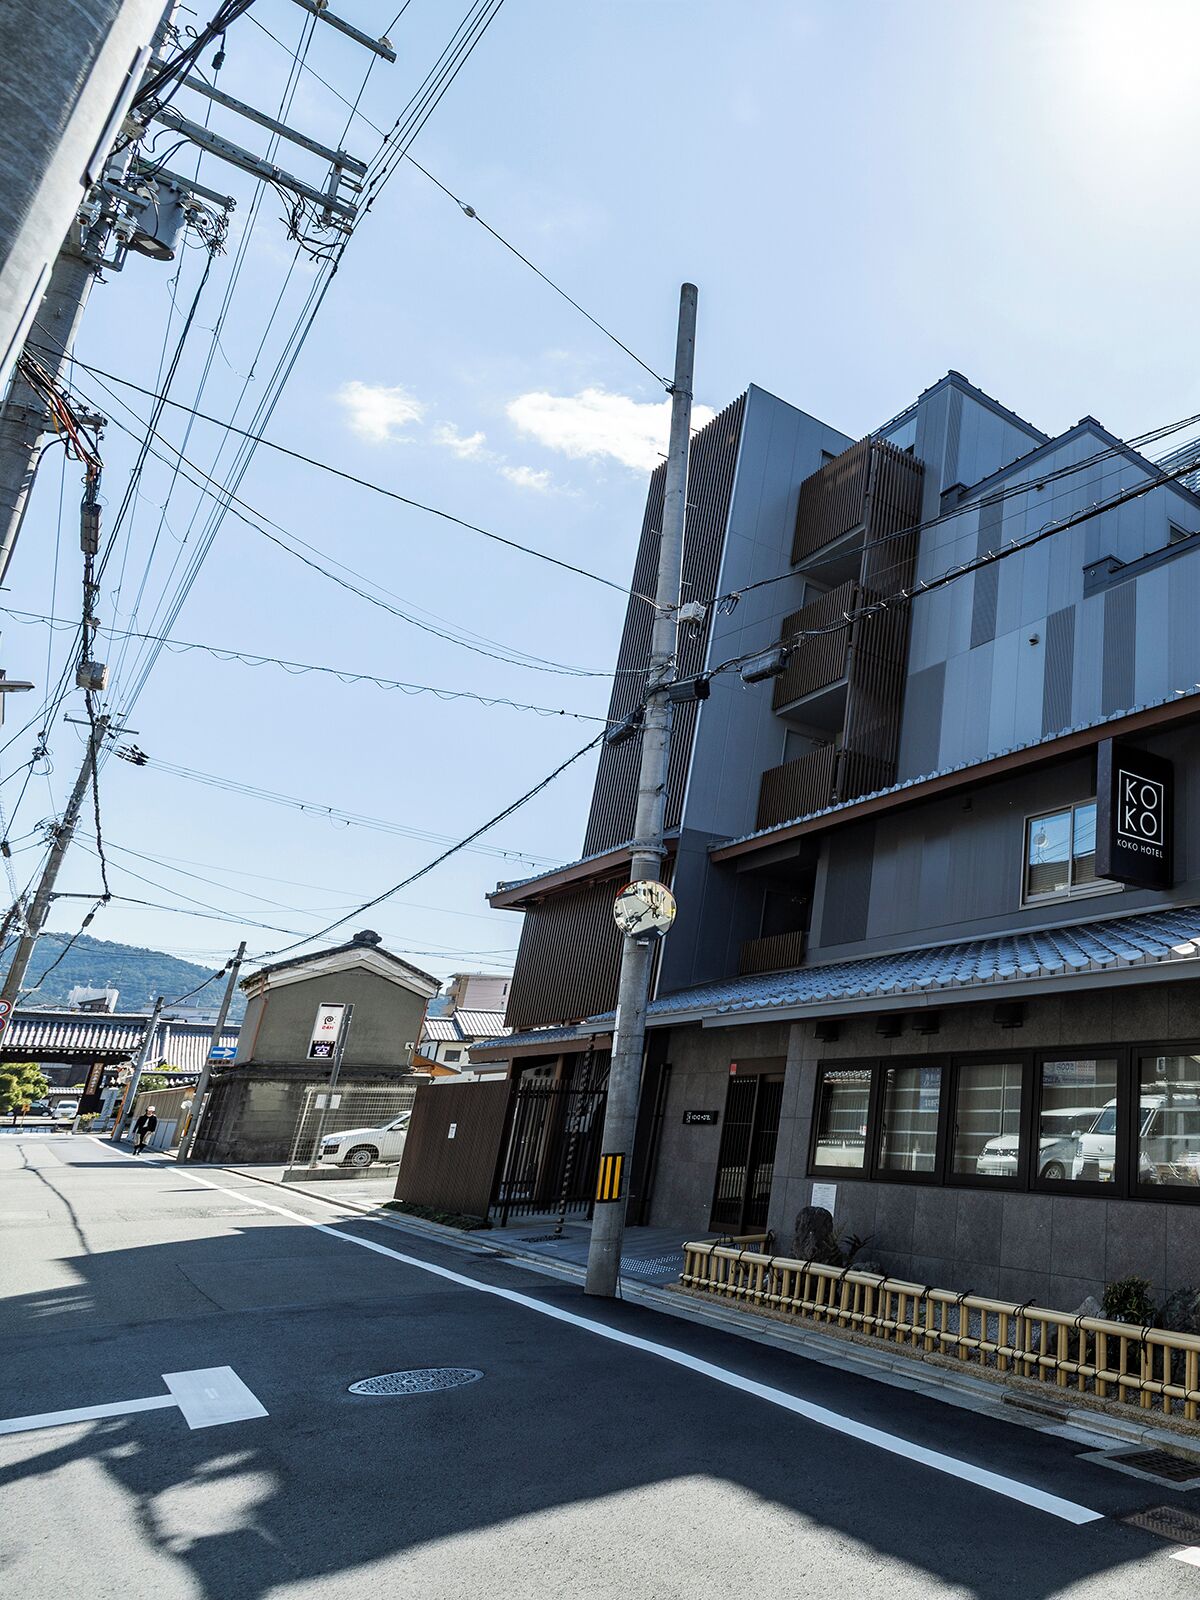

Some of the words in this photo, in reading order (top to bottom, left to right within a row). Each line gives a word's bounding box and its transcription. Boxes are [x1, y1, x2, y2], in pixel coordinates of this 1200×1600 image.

[1116, 838, 1139, 852] KOKO
[1140, 844, 1163, 859] HOTEL
[313, 1044, 331, 1057] 空
